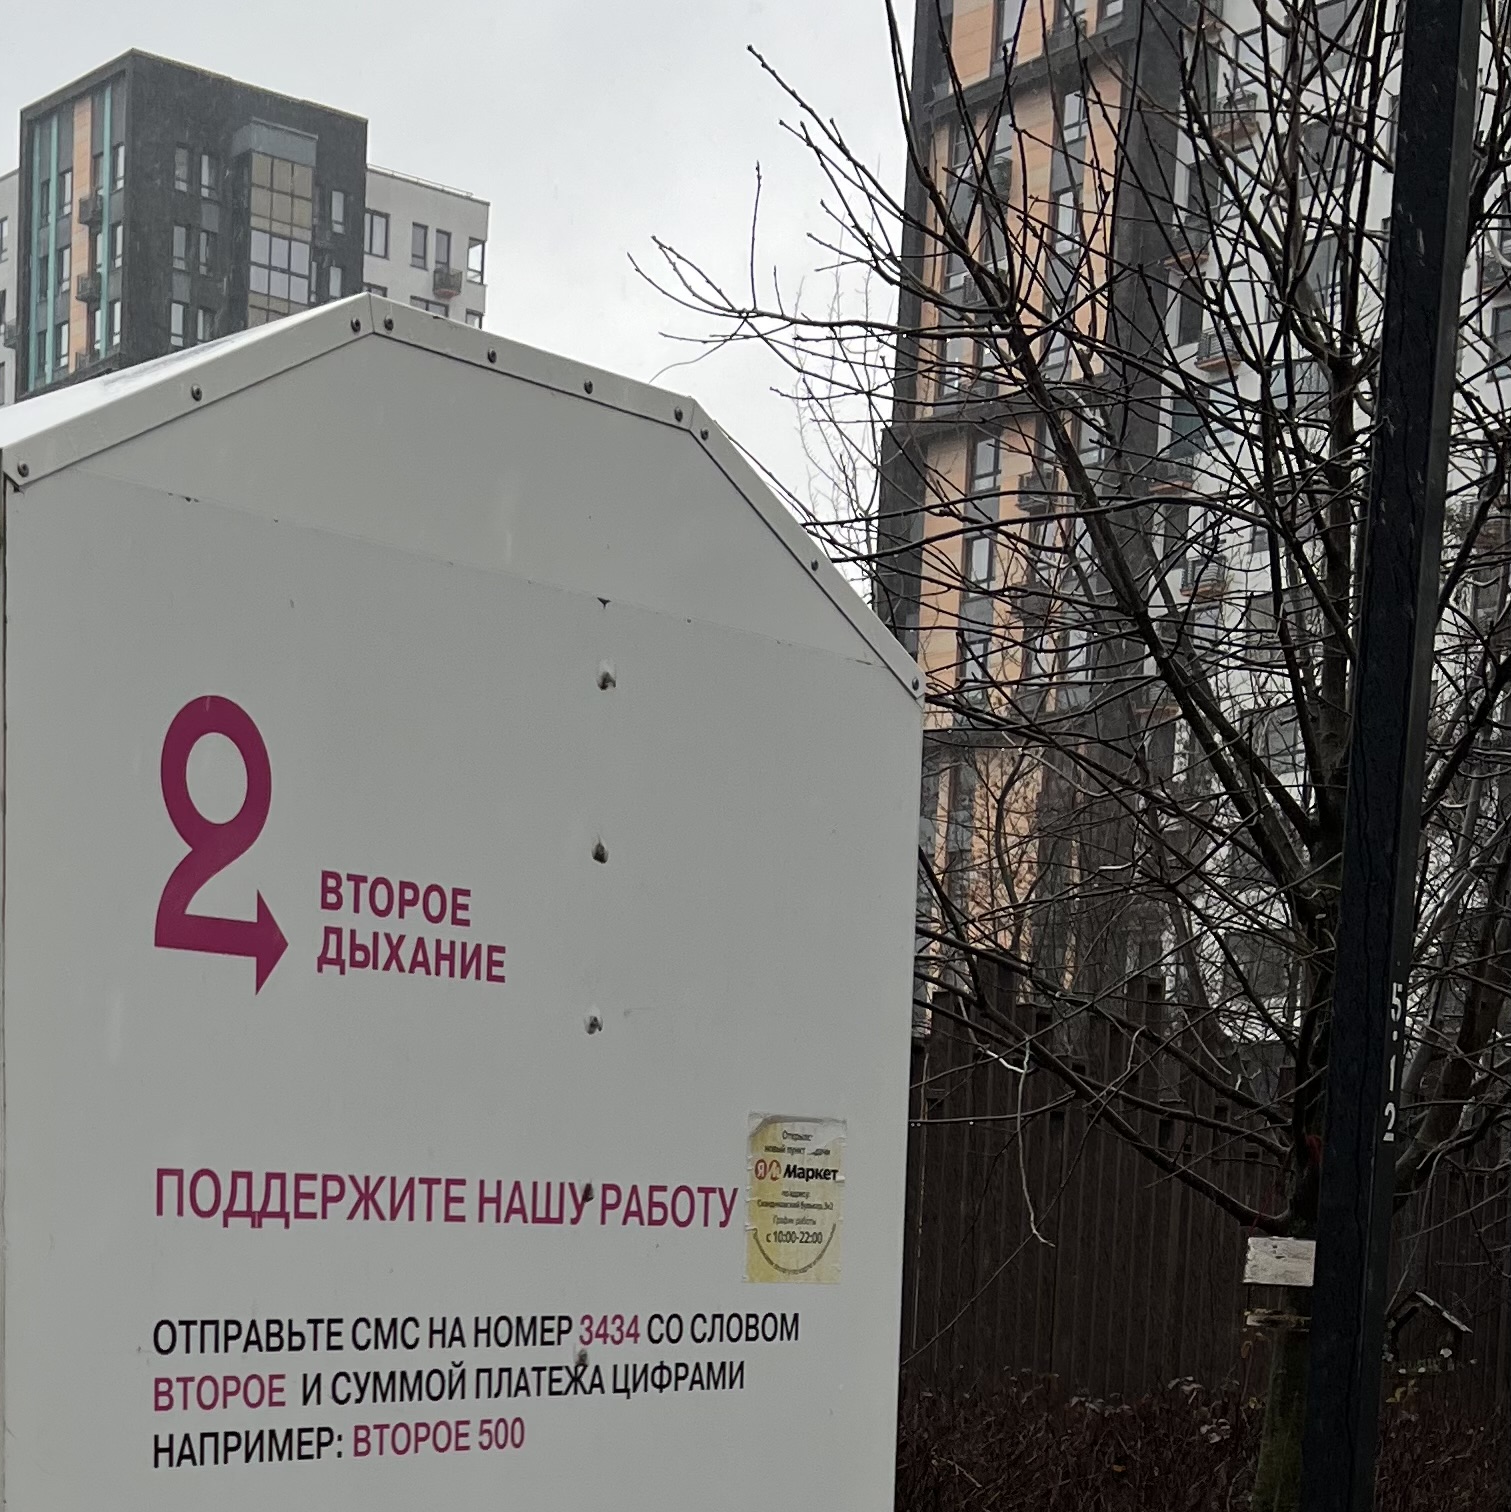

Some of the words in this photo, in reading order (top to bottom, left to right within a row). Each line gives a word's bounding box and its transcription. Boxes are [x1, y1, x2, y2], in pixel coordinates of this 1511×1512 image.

[321, 870, 471, 927] ВТОРОЕ
[317, 926, 506, 983] ДЫХАНИЕ
[783, 1163, 840, 1182] Маркет
[157, 1168, 466, 1229] ПОДДЕРЖИТЕ
[478, 1179, 594, 1225] НАШУ
[600, 1183, 739, 1228] РАБОТУ
[773, 1230, 823, 1244] 10:00-22:00
[153, 1318, 343, 1355] ОТПРАВЬТЕ
[352, 1317, 419, 1351] СМС
[429, 1317, 466, 1348] НА
[474, 1316, 572, 1348] НОМЕР
[579, 1314, 640, 1345] 3434
[647, 1314, 683, 1344] СО
[691, 1313, 799, 1343] СЛОВОМ
[155, 1374, 285, 1411] ВТОРОЕ
[302, 1373, 321, 1406] И
[332, 1361, 466, 1405] СУММОЙ
[475, 1363, 605, 1399] ПЛАТЕЖА
[612, 1361, 744, 1399] ЦИФРАМИ
[154, 1427, 342, 1468] НАПРИМЕР:
[354, 1420, 470, 1457] ВТОРОЕ
[479, 1417, 524, 1450] 500
